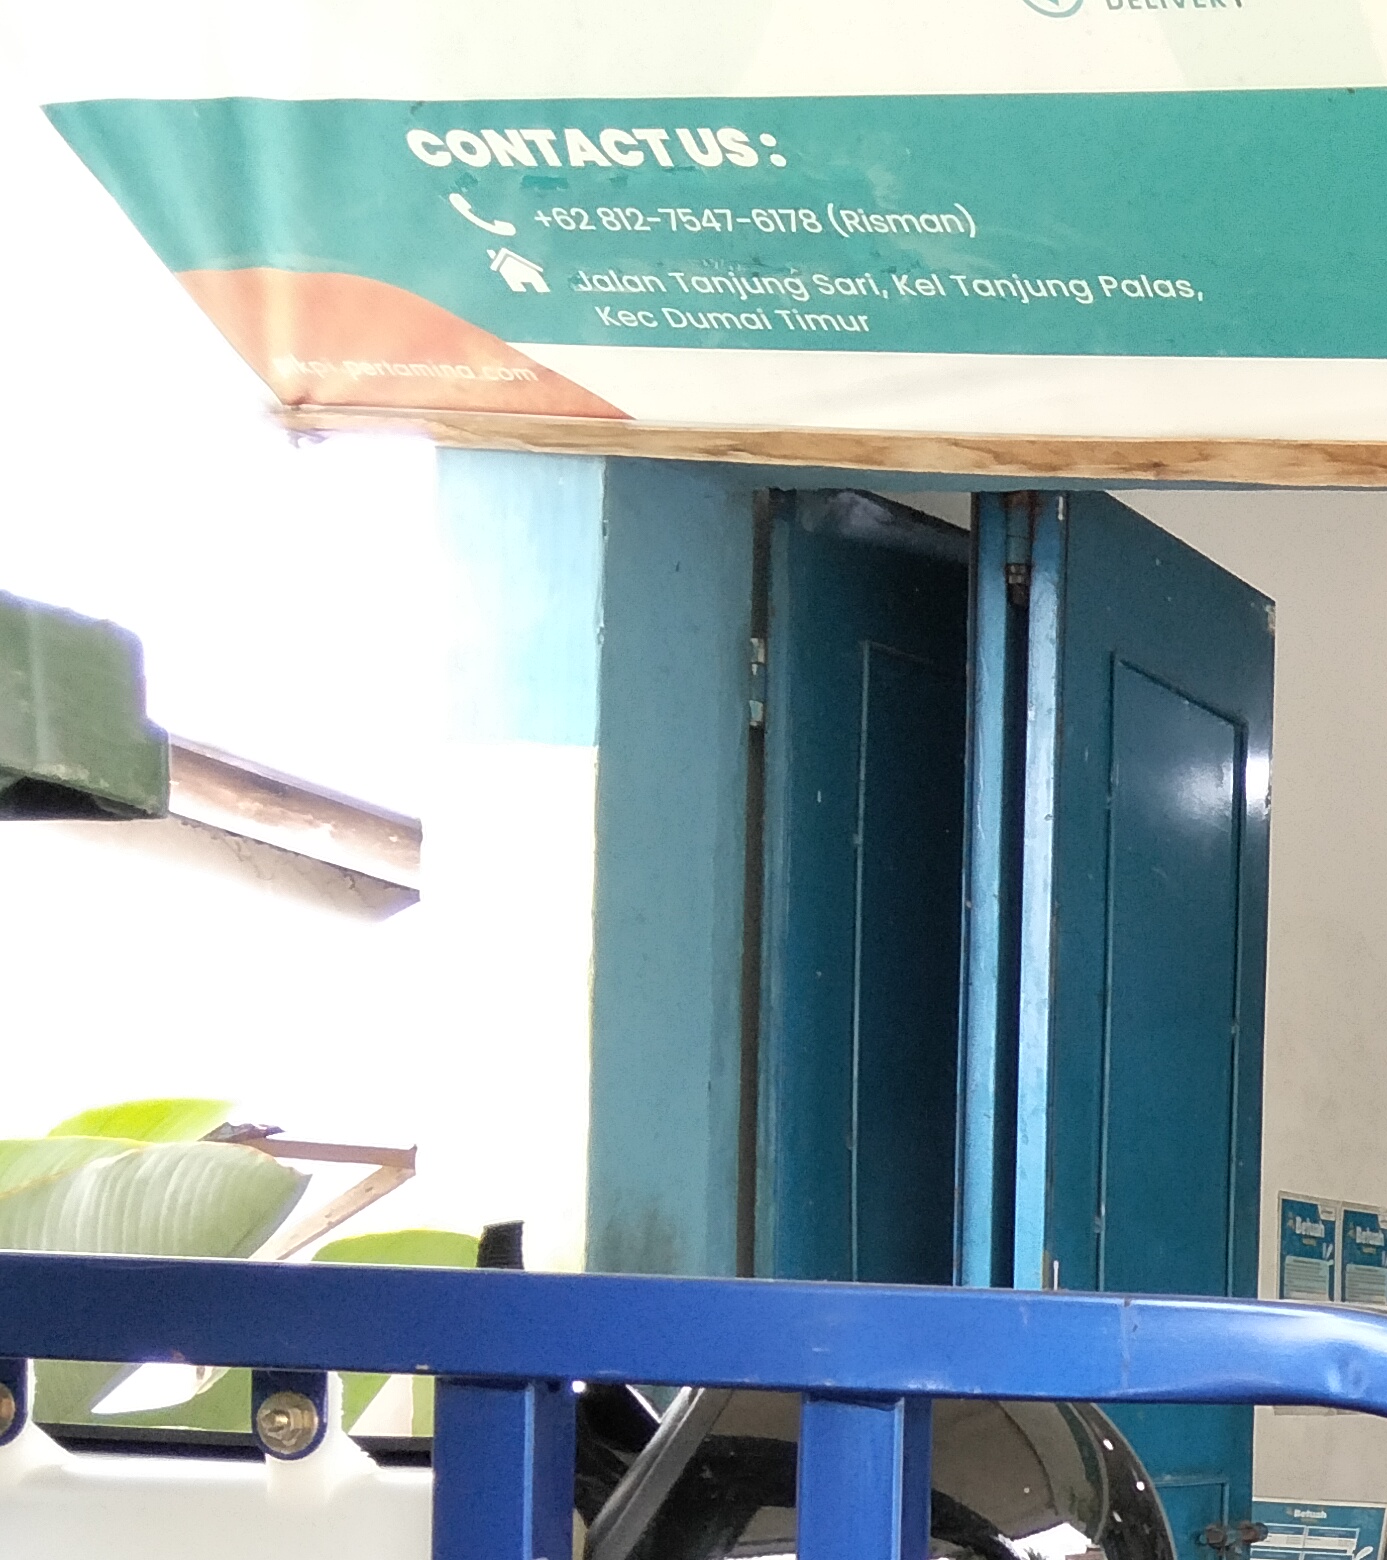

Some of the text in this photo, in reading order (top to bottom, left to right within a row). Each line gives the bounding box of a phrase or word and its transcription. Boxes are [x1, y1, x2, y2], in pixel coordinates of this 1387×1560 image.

[406, 128, 675, 167] CONTACT
[534, 203, 976, 238] +62 812-7547-6178 (Risman)
[575, 269, 1203, 304] Jalan Tanjung Sari, Kel Tanjung Palas,
[595, 306, 869, 332] Kec Dumai Timur
